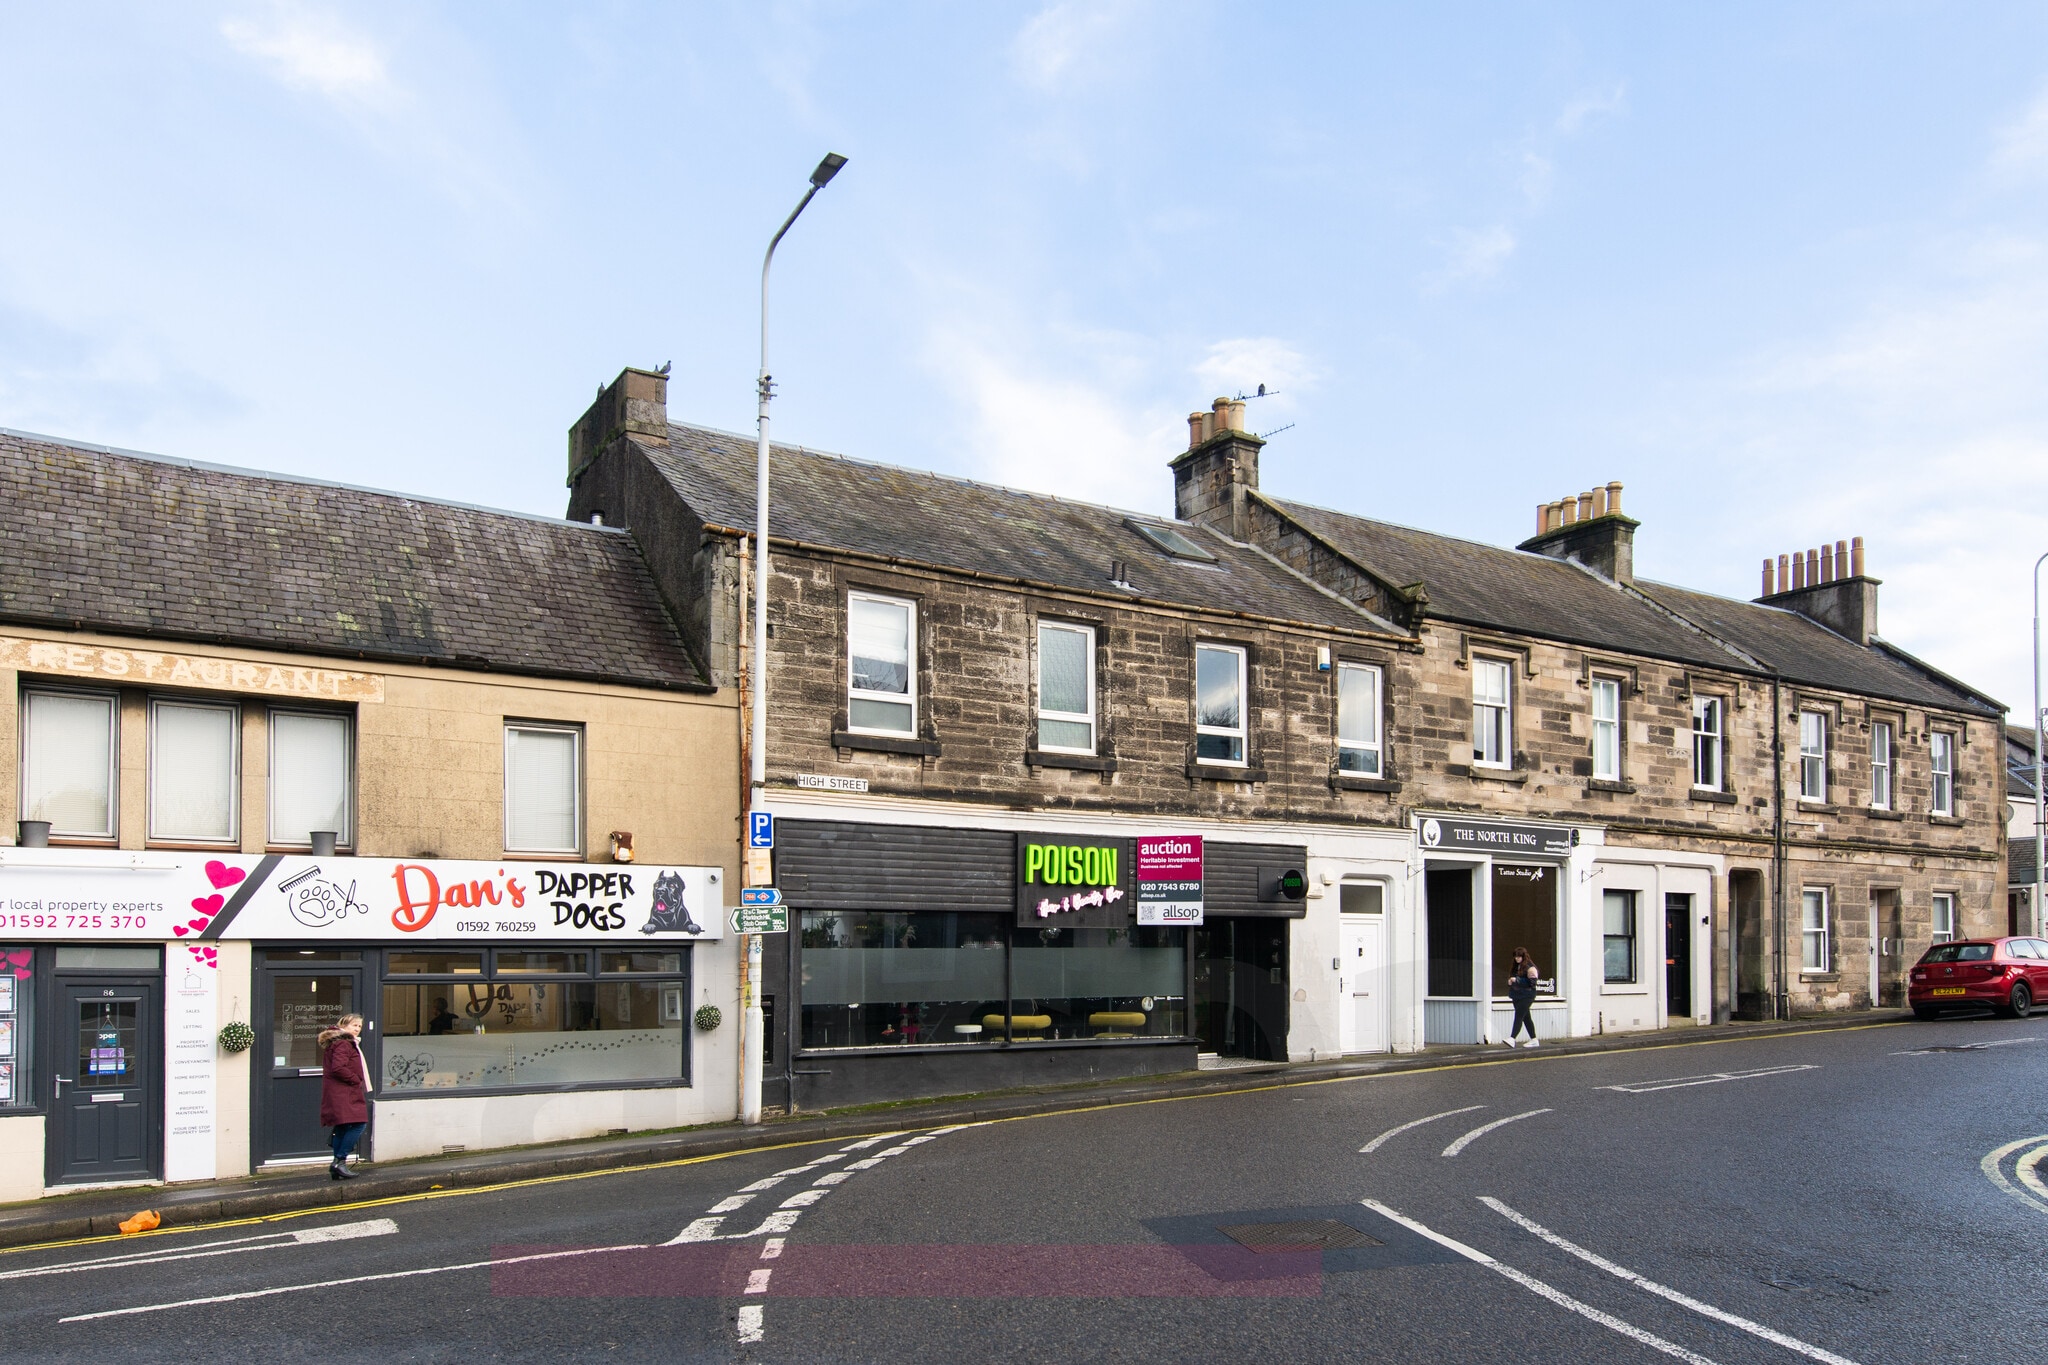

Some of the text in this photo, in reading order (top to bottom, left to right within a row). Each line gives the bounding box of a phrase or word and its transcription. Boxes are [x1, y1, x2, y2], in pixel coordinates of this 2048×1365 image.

[26, 643, 348, 695] RESTAURANT
[798, 775, 868, 790] HIGH STREET
[755, 814, 769, 833] P
[1453, 828, 1537, 846] THE NORTH KING
[1141, 839, 1191, 855] auction
[1025, 844, 1118, 886] POISON
[1516, 868, 1532, 877] Studio
[1140, 883, 1156, 891] 020
[1158, 883, 1178, 891] 7543
[1283, 877, 1301, 887] POISON
[391, 864, 635, 932] Dan's DAPPER
[9, 899, 43, 910] local
[48, 900, 108, 913] property
[112, 901, 163, 913] experts
[1162, 904, 1199, 920] allsop
[65, 915, 102, 929] 725
[110, 915, 146, 929] 370
[550, 901, 626, 931] DOGS
[456, 921, 536, 932] 01592 760259
[103, 989, 115, 997] 86
